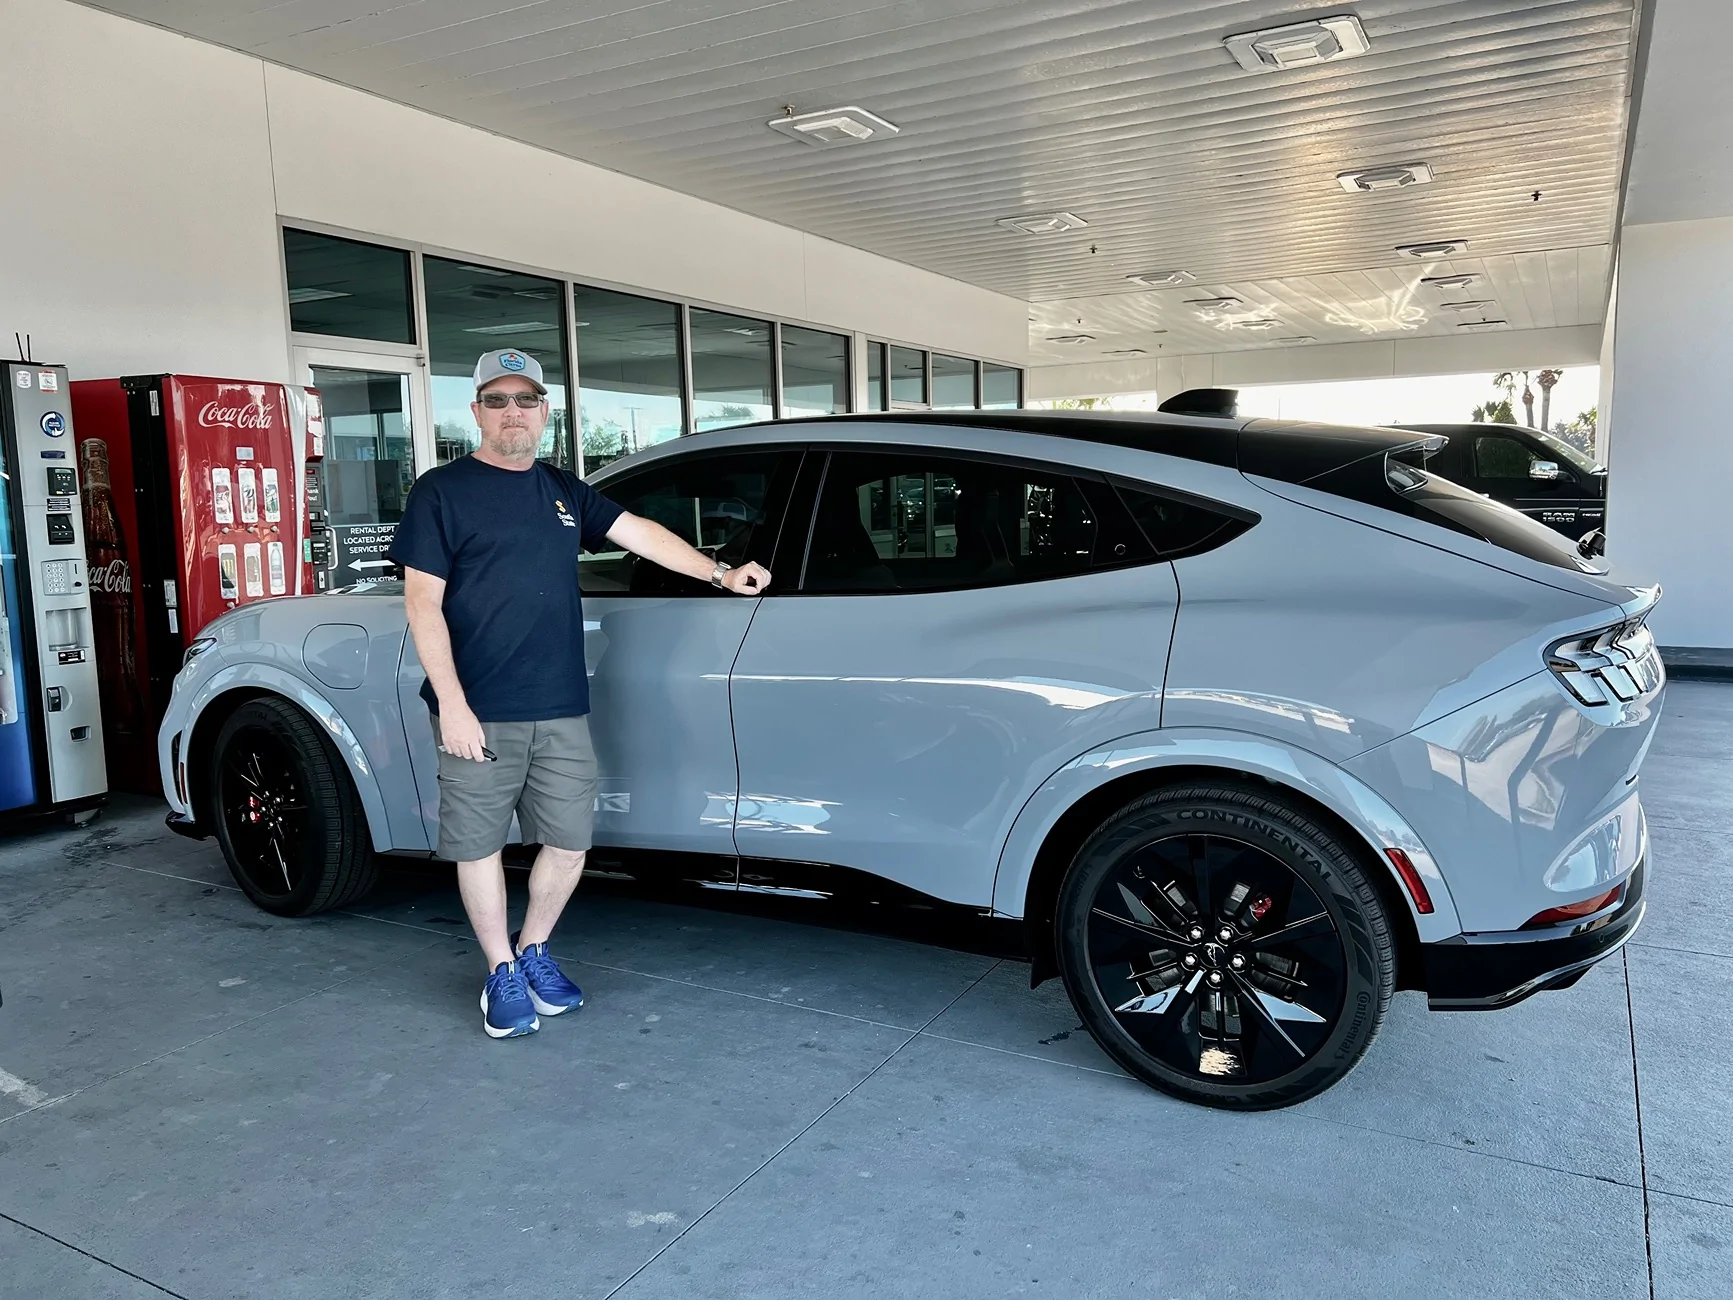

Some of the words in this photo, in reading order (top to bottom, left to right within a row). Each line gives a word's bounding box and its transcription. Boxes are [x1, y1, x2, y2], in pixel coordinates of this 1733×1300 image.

[350, 526, 376, 535] RENTAL
[343, 536, 375, 545] LOCATED
[349, 546, 378, 554] SERVICE
[1176, 808, 1333, 886] CONTINENTAL
